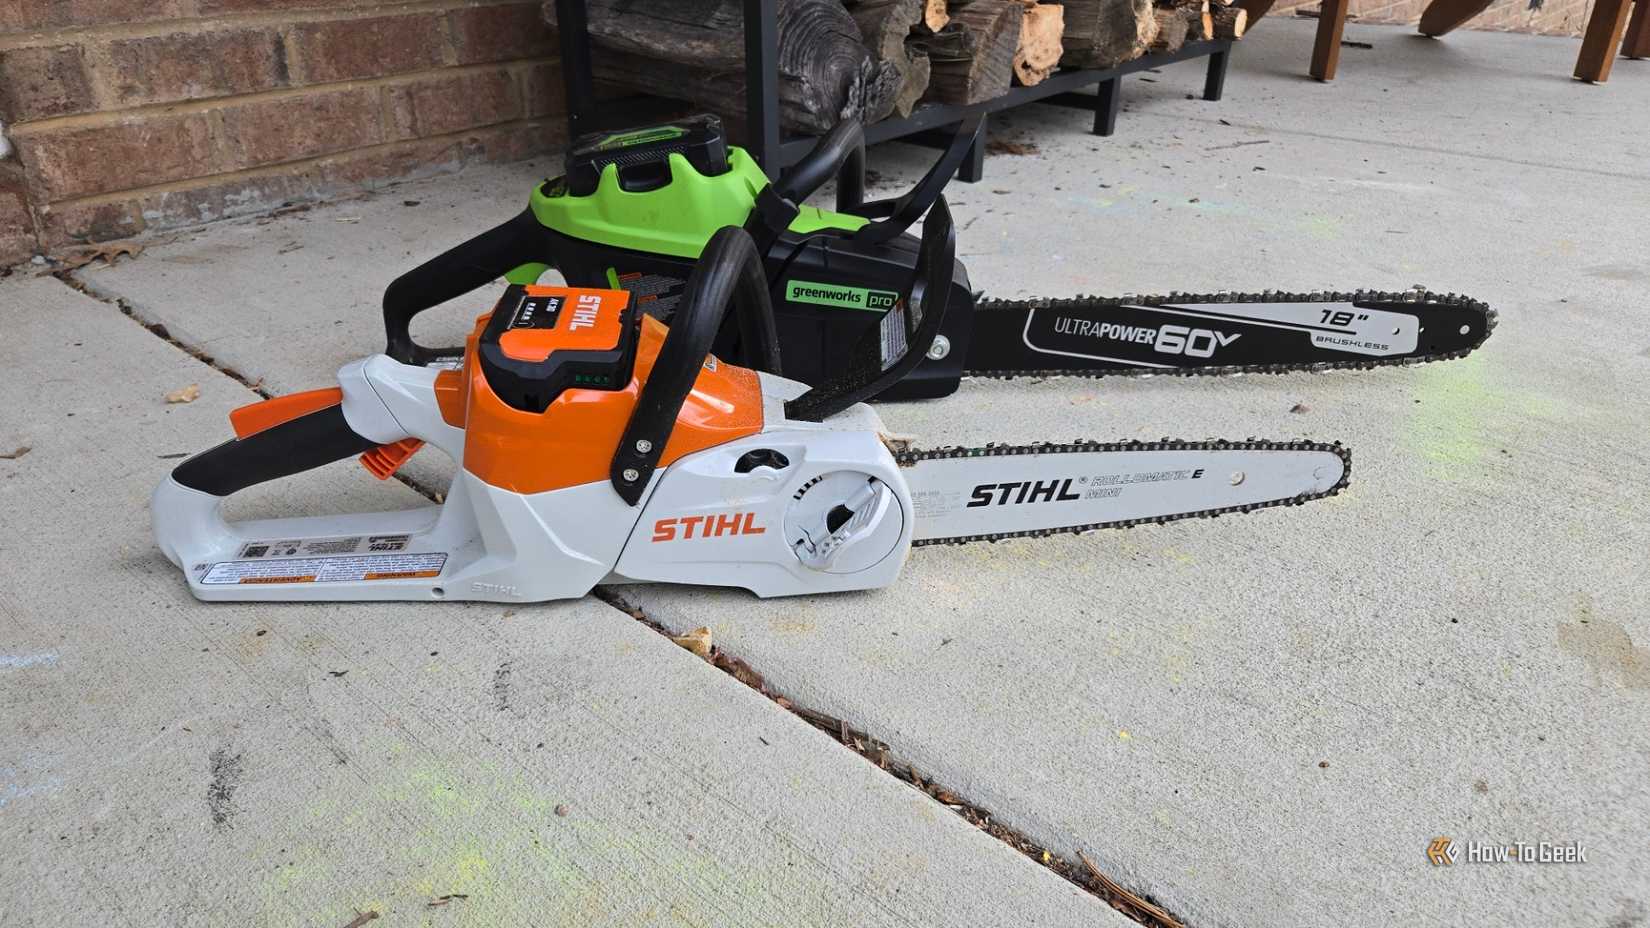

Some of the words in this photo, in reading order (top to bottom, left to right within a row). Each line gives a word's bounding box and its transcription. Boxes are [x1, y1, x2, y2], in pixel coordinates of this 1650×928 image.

[793, 286, 861, 303] greenworks
[869, 295, 892, 307] pro
[569, 295, 602, 330] STIHL
[1320, 309, 1369, 327] 18"
[1316, 335, 1389, 351] BRUSHLESS
[966, 478, 1080, 508] STIHL
[1090, 469, 1190, 487] ROLLOMATIC
[1191, 468, 1205, 479] E
[1084, 487, 1122, 500] MINI
[652, 512, 767, 543] STIHL
[471, 581, 522, 597] STIHL
